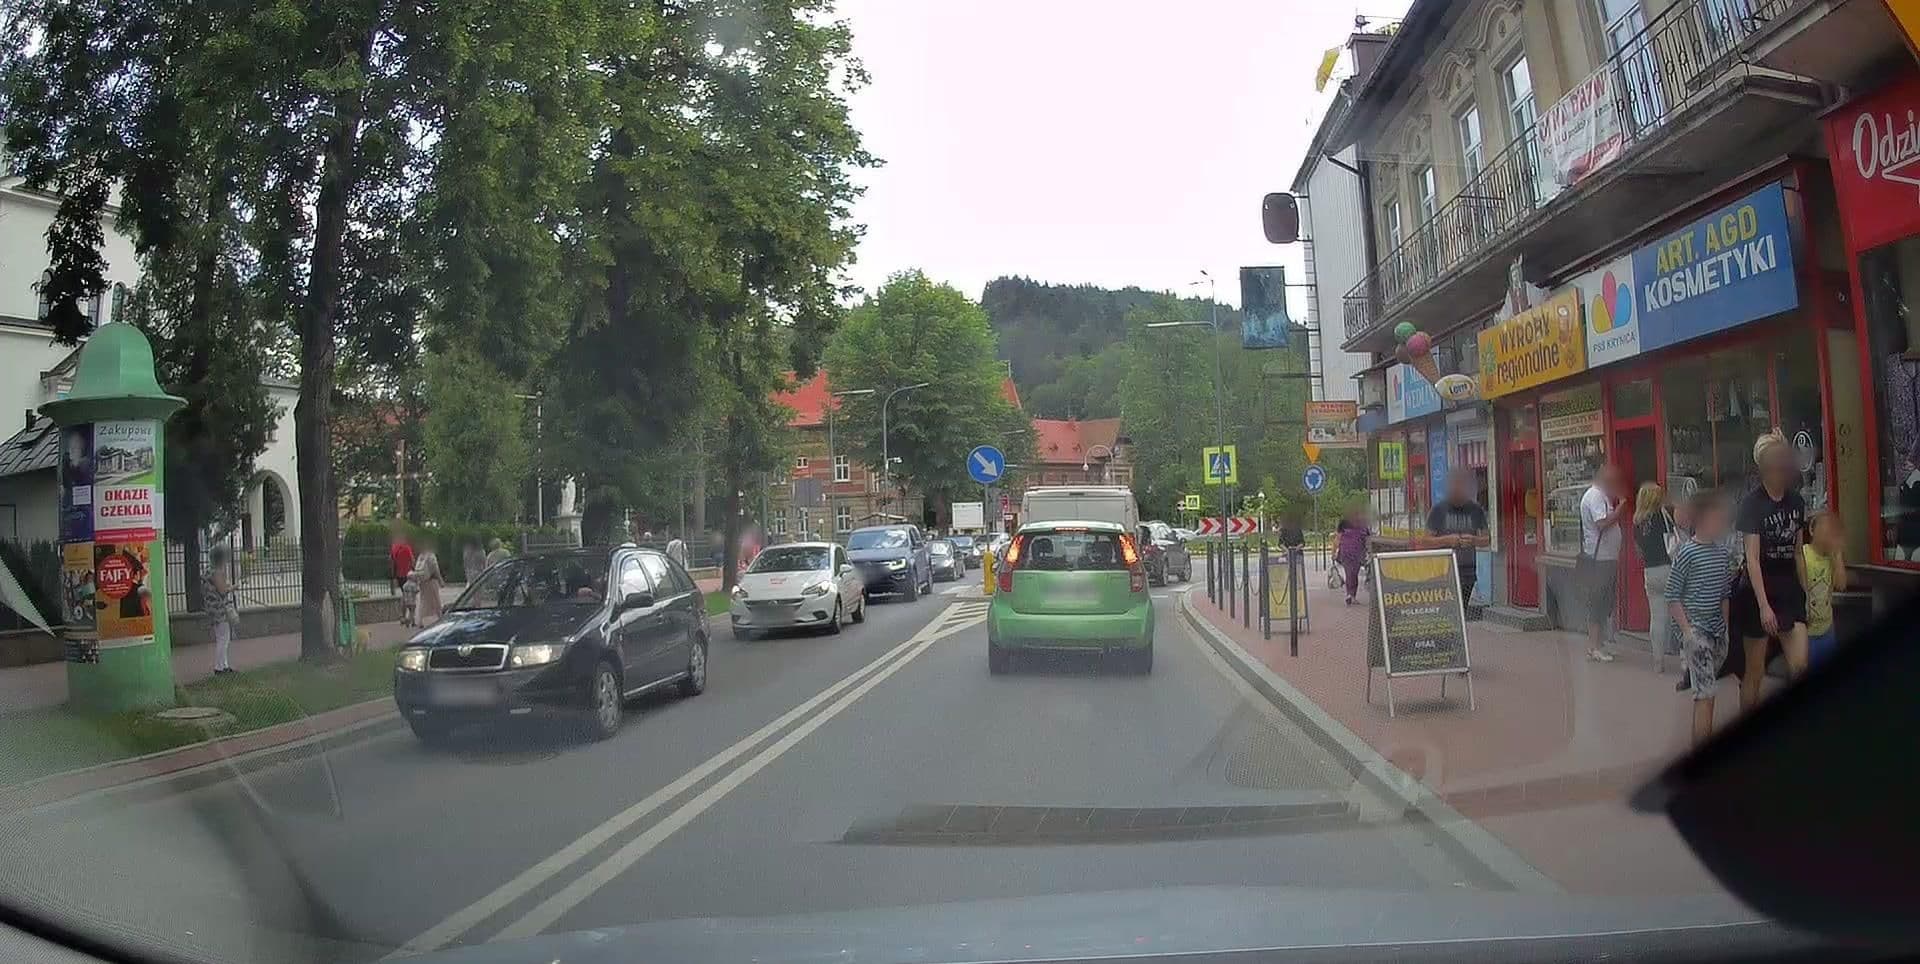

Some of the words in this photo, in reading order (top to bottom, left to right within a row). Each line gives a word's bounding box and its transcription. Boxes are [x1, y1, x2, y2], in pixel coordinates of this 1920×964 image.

[1853, 109, 1920, 178] Odzi
[1656, 231, 1700, 275] ART.
[1706, 204, 1758, 254] AGD
[1644, 234, 1776, 312] KOSMETYKI
[1499, 308, 1550, 354] WYROBY
[1497, 342, 1560, 388] regionalne
[104, 488, 149, 501] OKAZJE
